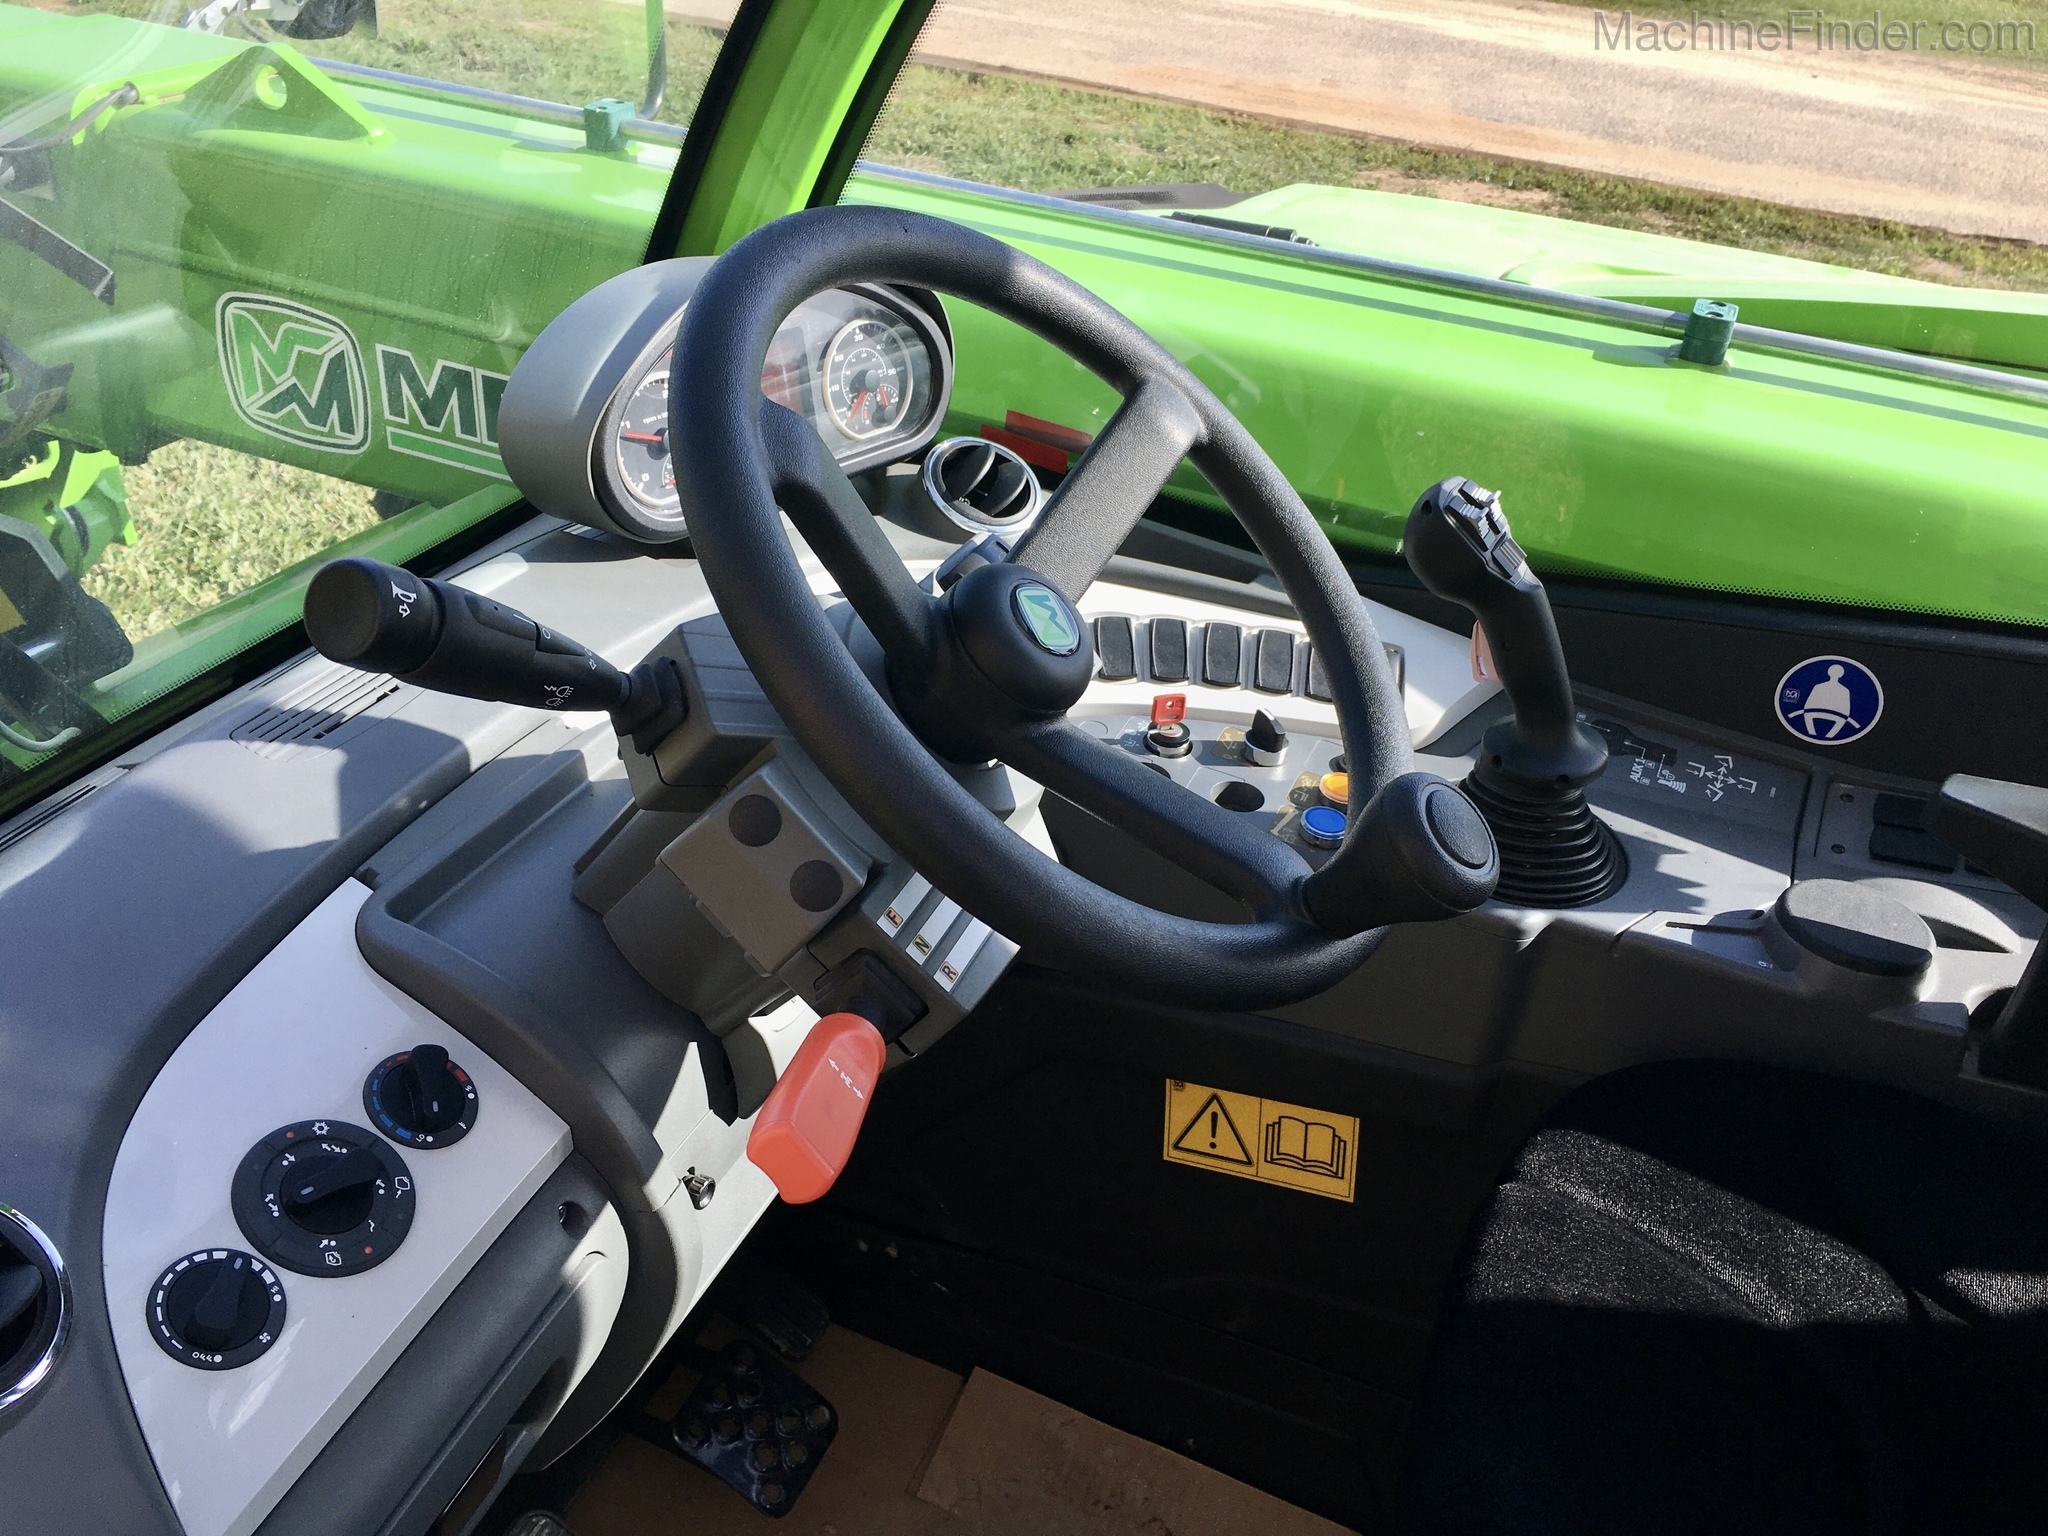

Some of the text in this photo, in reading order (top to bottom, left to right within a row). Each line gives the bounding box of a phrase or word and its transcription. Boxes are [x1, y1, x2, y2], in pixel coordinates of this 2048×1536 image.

[854, 334, 864, 342] 30
[876, 342, 886, 350] 40
[834, 354, 844, 363] 20
[887, 368, 897, 376] 50
[831, 384, 840, 392] 10
[643, 416, 657, 424] rpm
[641, 473, 650, 482] 0
[1629, 762, 1644, 783] AUX
[886, 909, 899, 926] F
[914, 936, 930, 953] N
[941, 965, 957, 981] R
[415, 1134, 425, 1143] LO
[270, 1285, 280, 1294] HI
[192, 1351, 213, 1362] OFF
